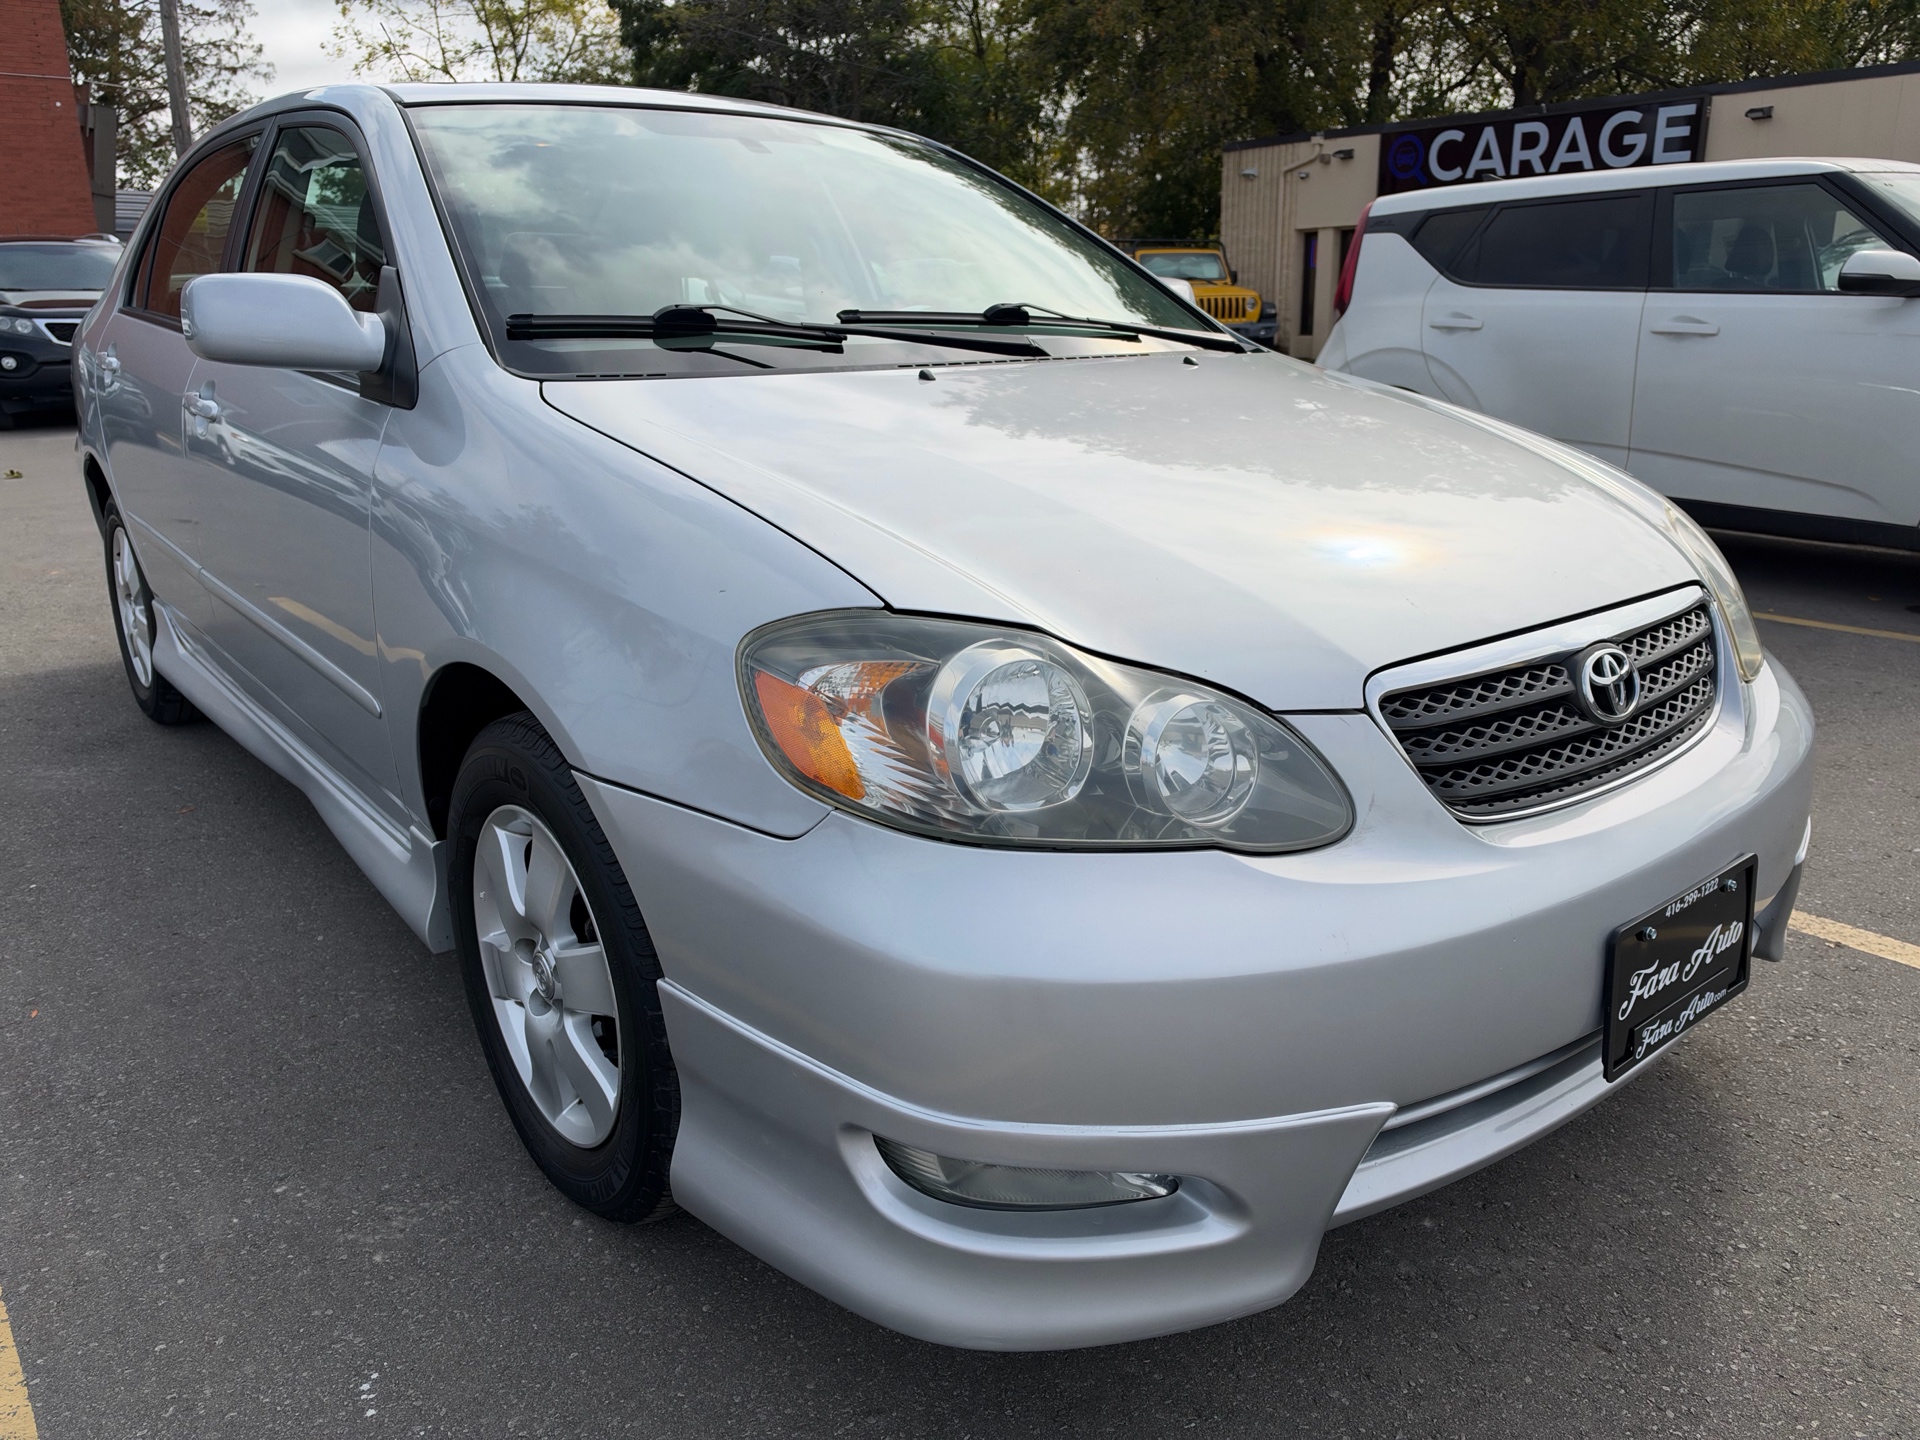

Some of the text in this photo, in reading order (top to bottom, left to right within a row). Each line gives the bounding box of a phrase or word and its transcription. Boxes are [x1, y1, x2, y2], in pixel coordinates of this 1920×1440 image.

[1428, 103, 1697, 181] CARAGE
[1664, 877, 1720, 918] 416-299-1222
[1618, 920, 1744, 1021] Fara Auto
[1635, 1019, 1673, 1060] Fara
